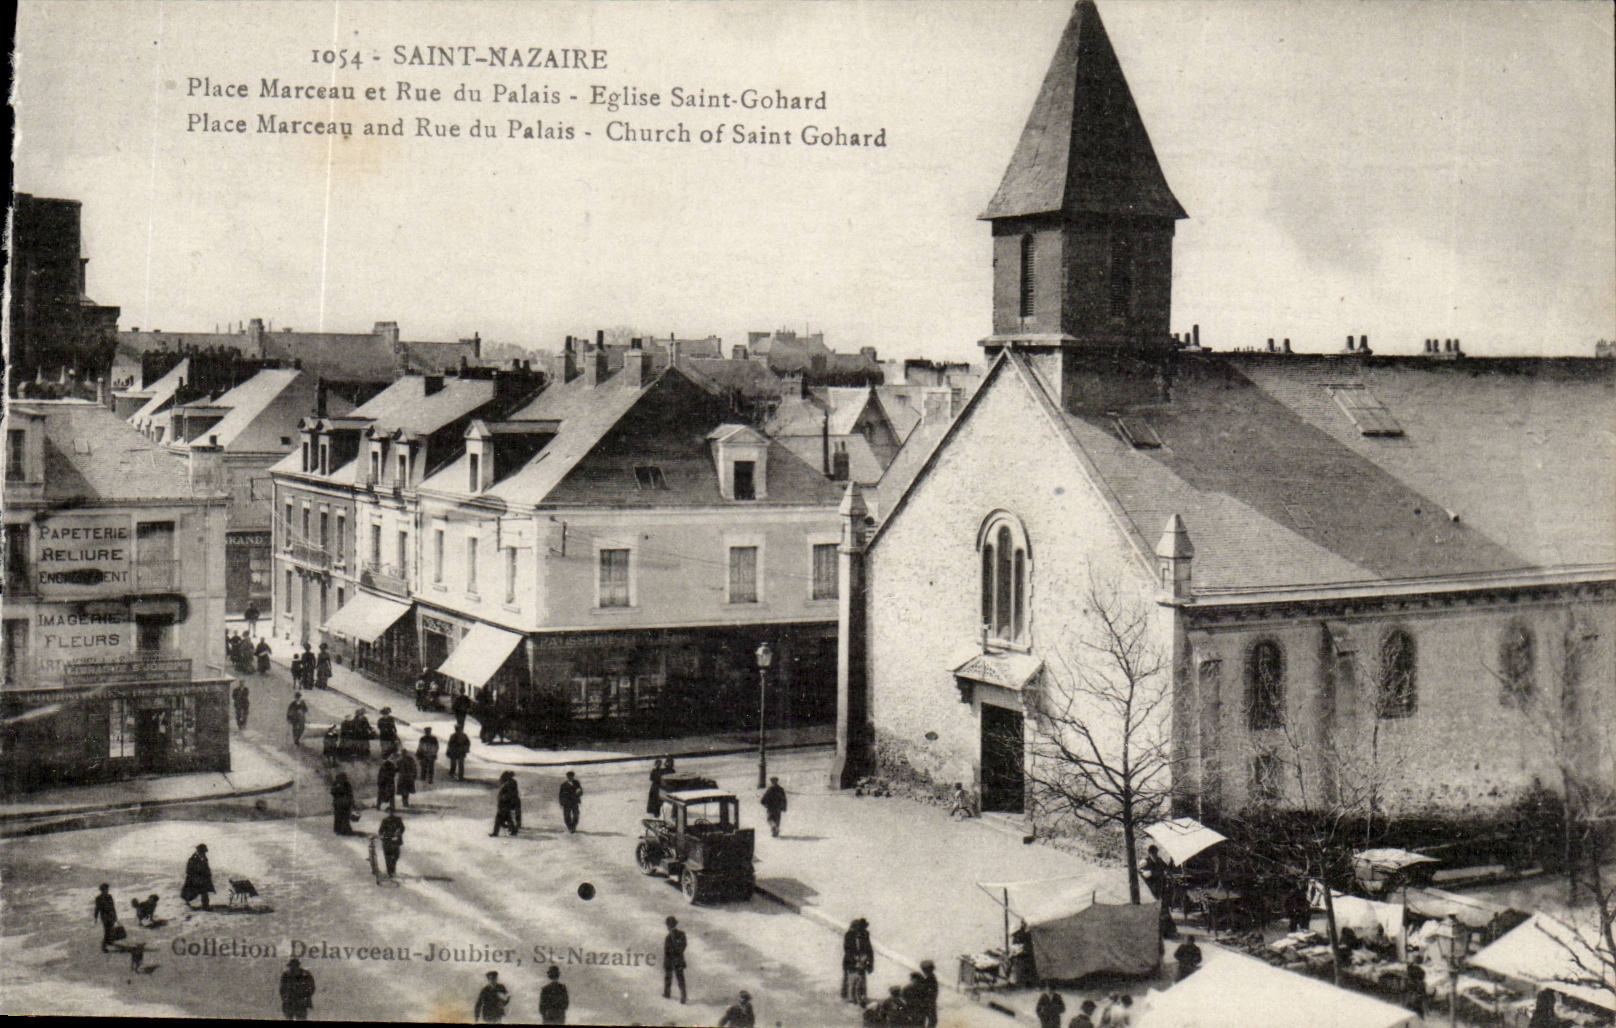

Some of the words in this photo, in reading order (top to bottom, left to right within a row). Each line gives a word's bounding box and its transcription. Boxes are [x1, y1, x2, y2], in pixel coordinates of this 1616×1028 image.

[39, 526, 128, 540] PAPETERIE
[41, 547, 124, 561] RELIURE
[44, 633, 120, 648] FLEURS
